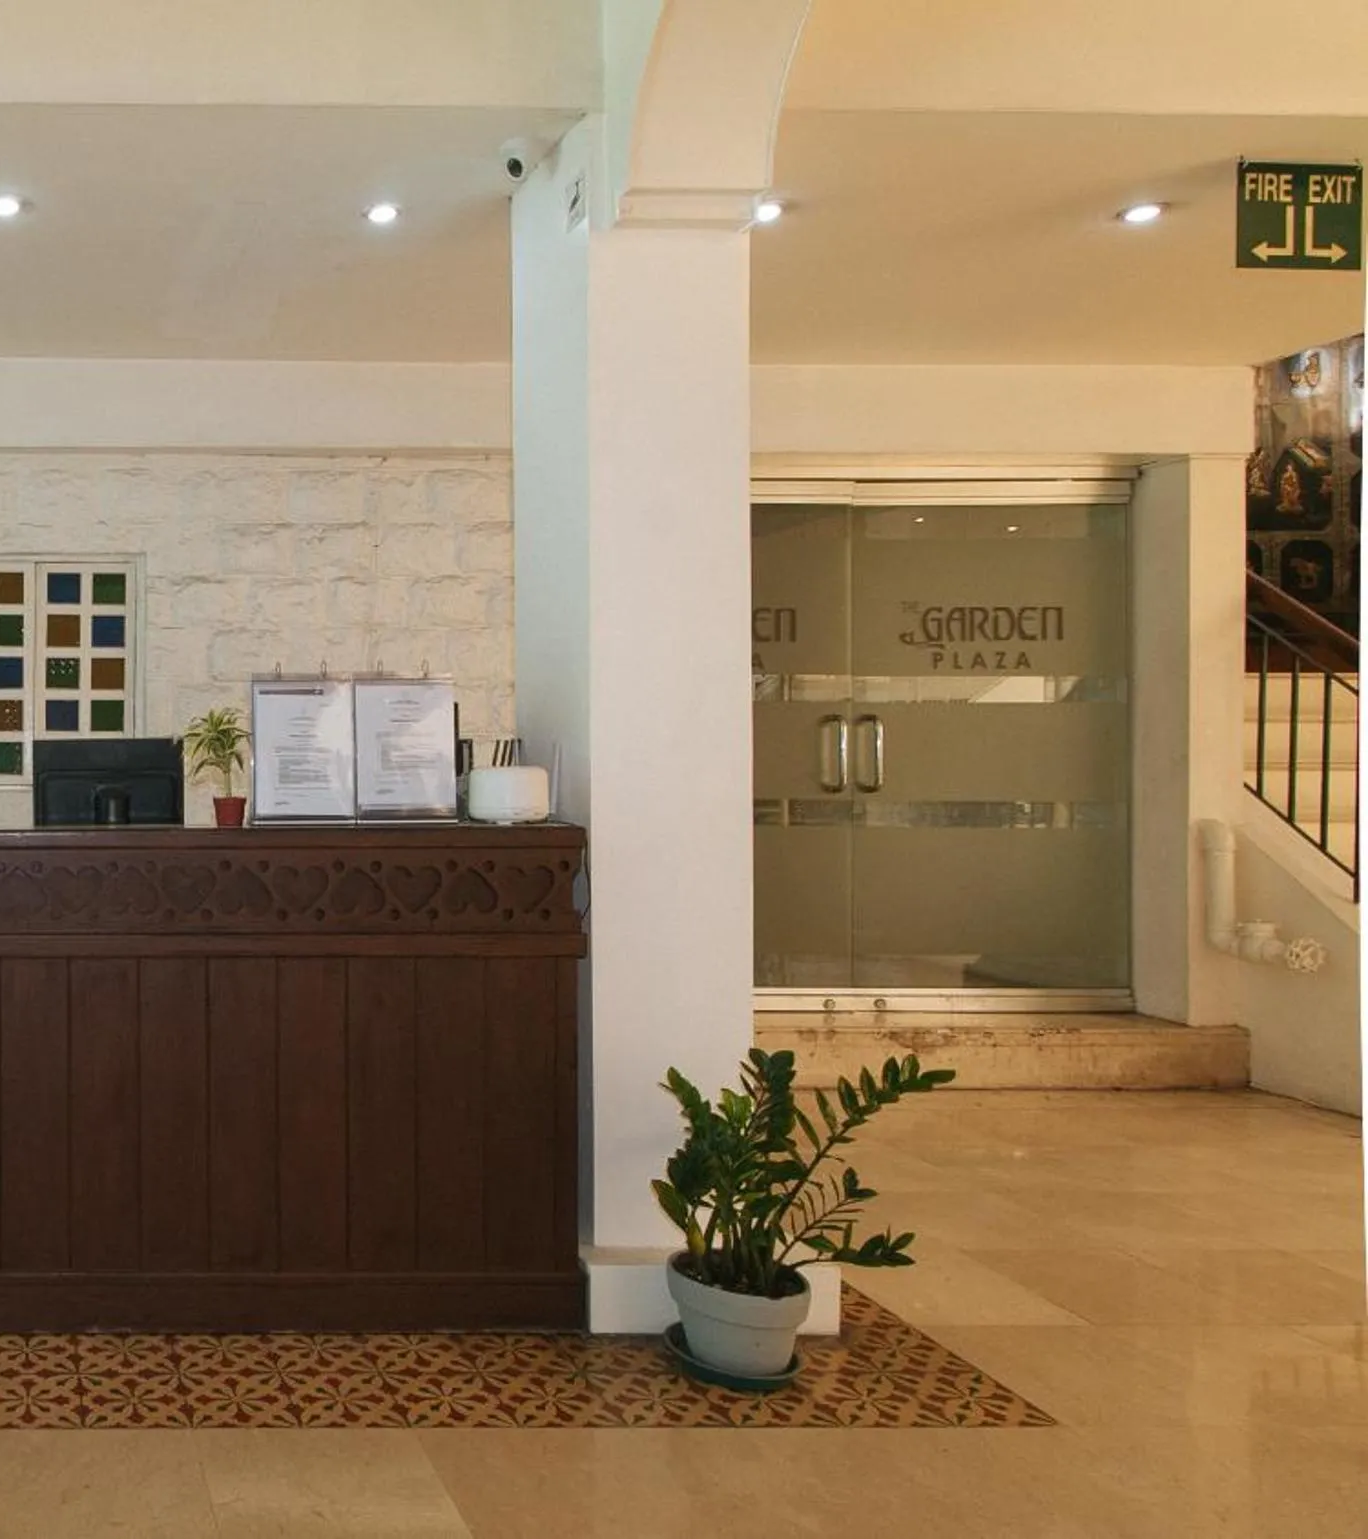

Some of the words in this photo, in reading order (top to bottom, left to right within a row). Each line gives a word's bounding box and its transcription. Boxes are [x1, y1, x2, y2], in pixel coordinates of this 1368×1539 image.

[1245, 172, 1293, 202] FIRE
[1309, 174, 1356, 204] EXIT
[922, 606, 1064, 643] GARDEN
[932, 651, 1031, 671] PLAZA
